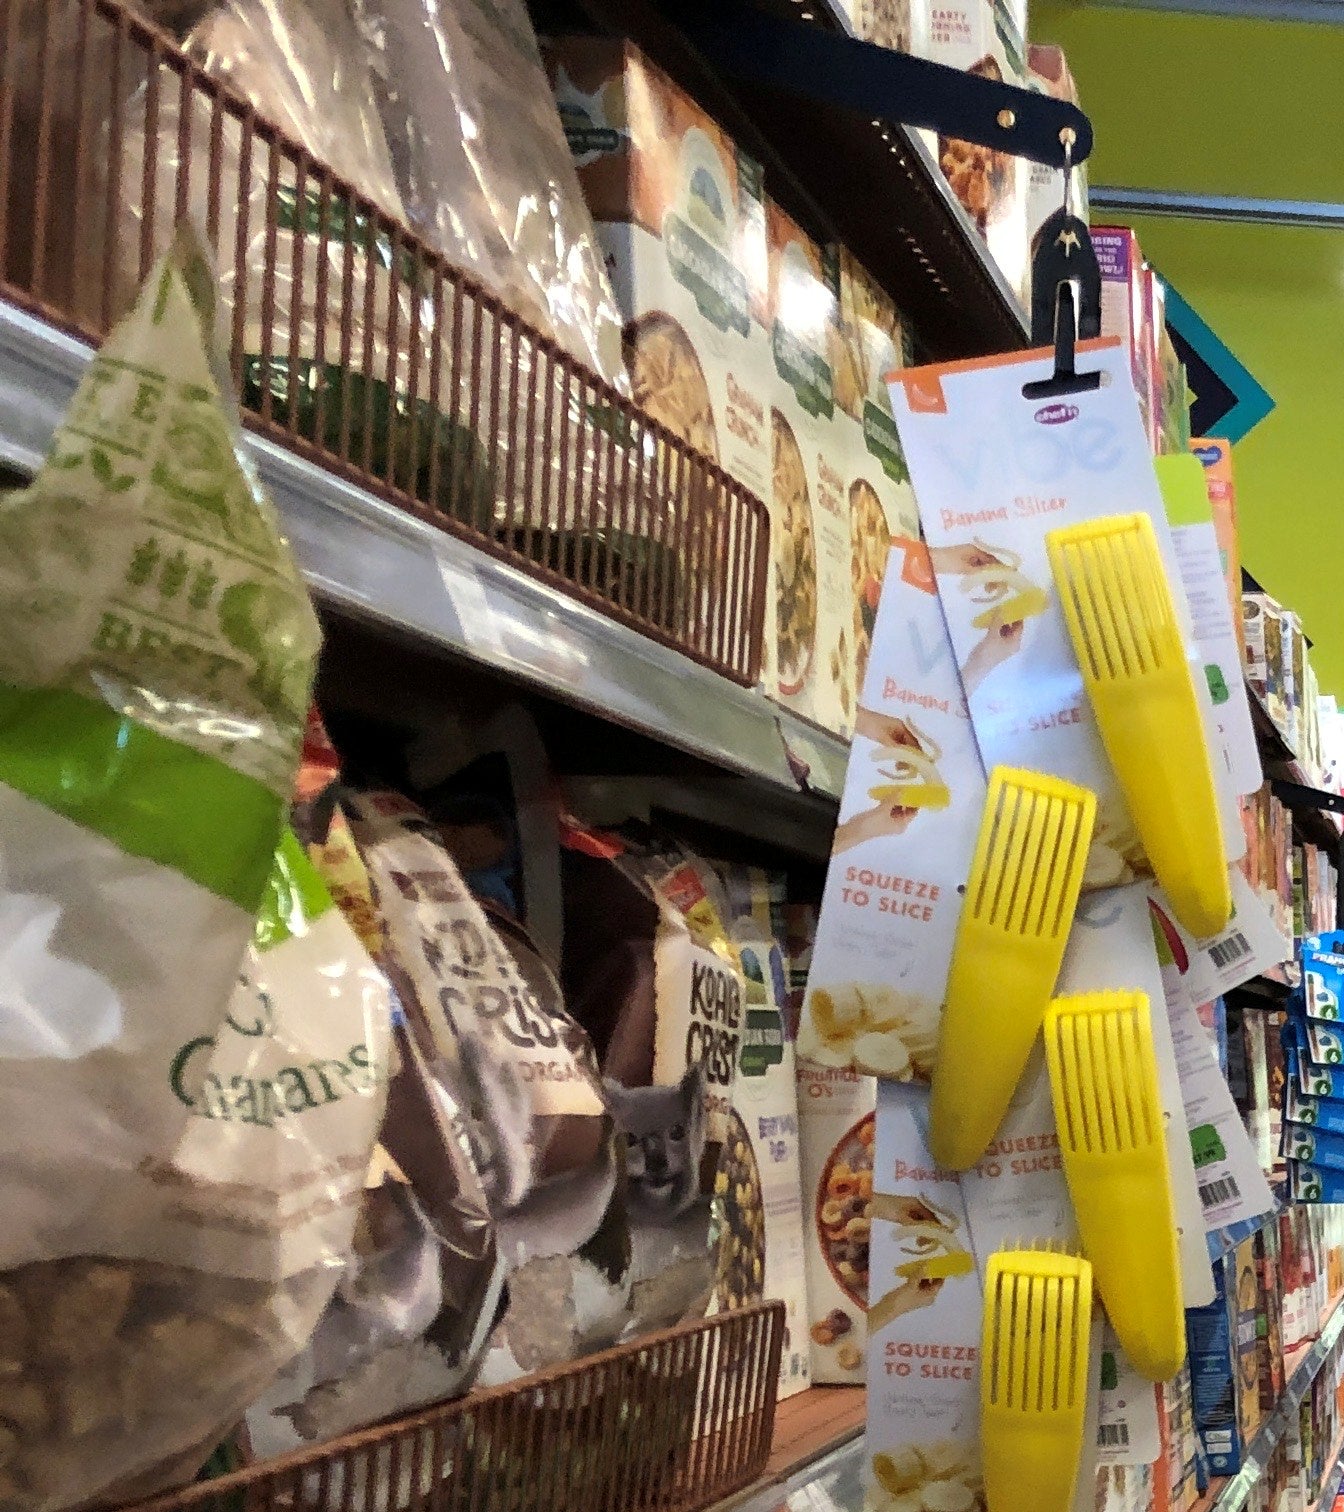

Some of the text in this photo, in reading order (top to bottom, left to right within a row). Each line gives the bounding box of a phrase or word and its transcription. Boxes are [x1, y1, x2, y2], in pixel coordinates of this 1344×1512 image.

[845, 866, 941, 903] SQUEEZE
[841, 887, 934, 922] TO SLICE
[976, 1154, 1063, 1179] TO SLICE
[884, 1341, 977, 1362] SQUEEZE
[884, 1361, 973, 1381] TO SLICE
